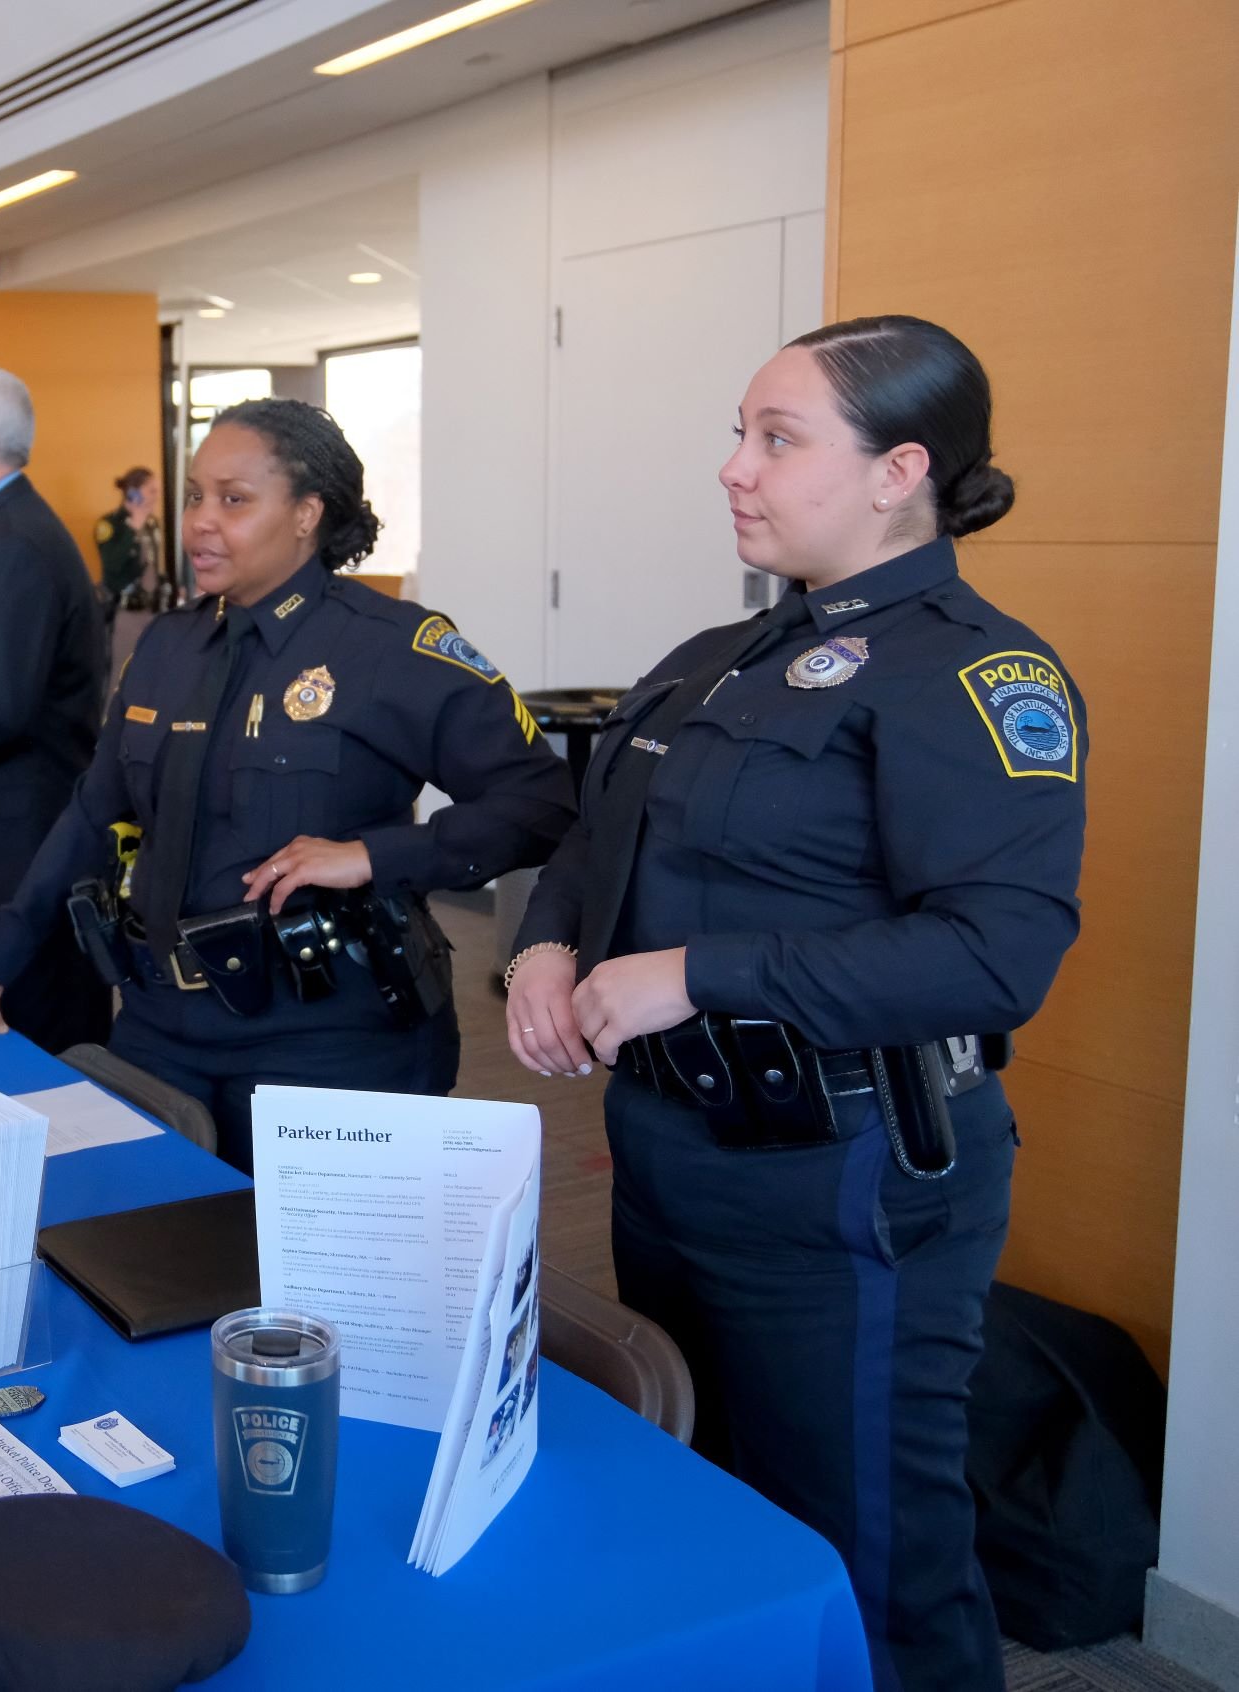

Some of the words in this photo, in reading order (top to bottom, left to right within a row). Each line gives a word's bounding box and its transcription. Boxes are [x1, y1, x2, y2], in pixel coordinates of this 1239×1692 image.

[826, 640, 857, 661] POLICE
[979, 663, 1060, 693] POLICE
[1000, 684, 1058, 699] NANTUCKET
[1005, 711, 1016, 721] OF
[1004, 723, 1019, 746] TOWN
[277, 1125, 332, 1140] Parker
[336, 1128, 393, 1143] Luther
[241, 1413, 300, 1432] POLICE
[16, 1455, 41, 1477] Police
